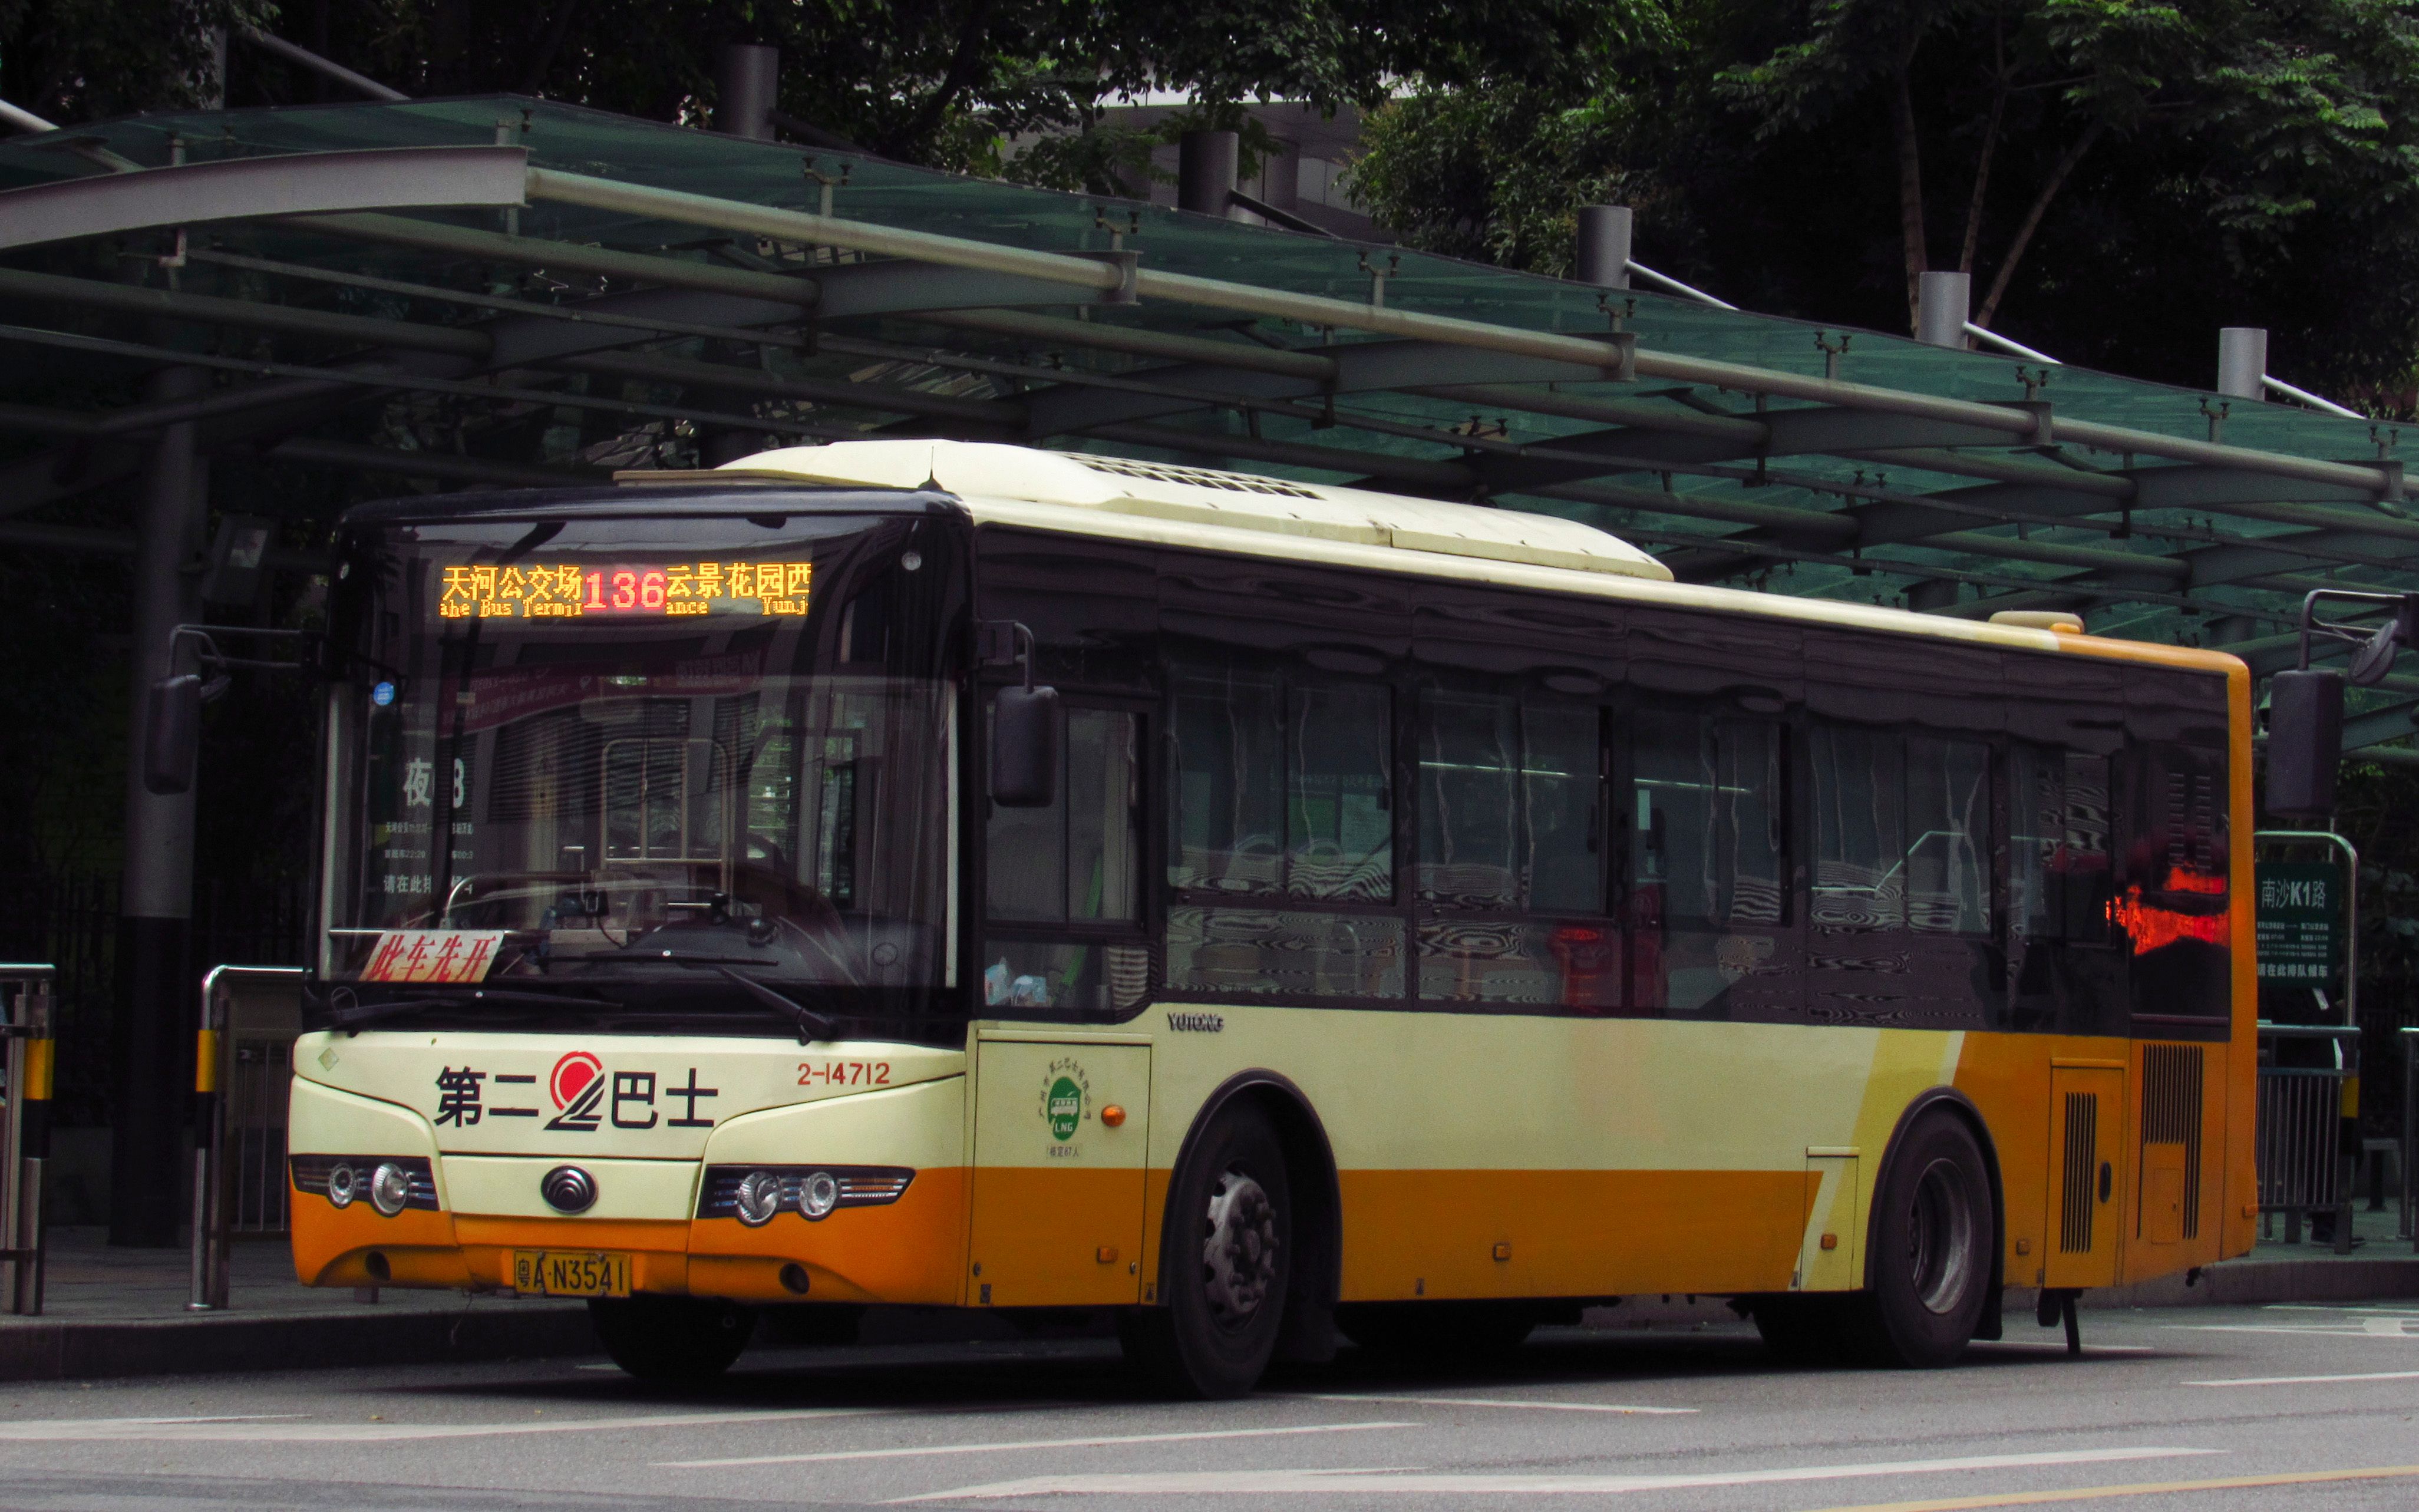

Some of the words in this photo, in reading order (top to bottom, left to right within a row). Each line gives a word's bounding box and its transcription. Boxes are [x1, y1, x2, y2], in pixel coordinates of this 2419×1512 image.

[443, 564, 582, 600] 天河公交场
[583, 570, 666, 610] 136
[666, 563, 811, 598] 云景花园西
[479, 599, 511, 618] Bus
[2261, 877, 2326, 909] 南沙K1路
[367, 934, 496, 982] 此车先开
[1167, 1012, 1224, 1032] YUTONG
[797, 1062, 890, 1085] 2-14712
[1055, 1122, 1073, 1132] LNG
